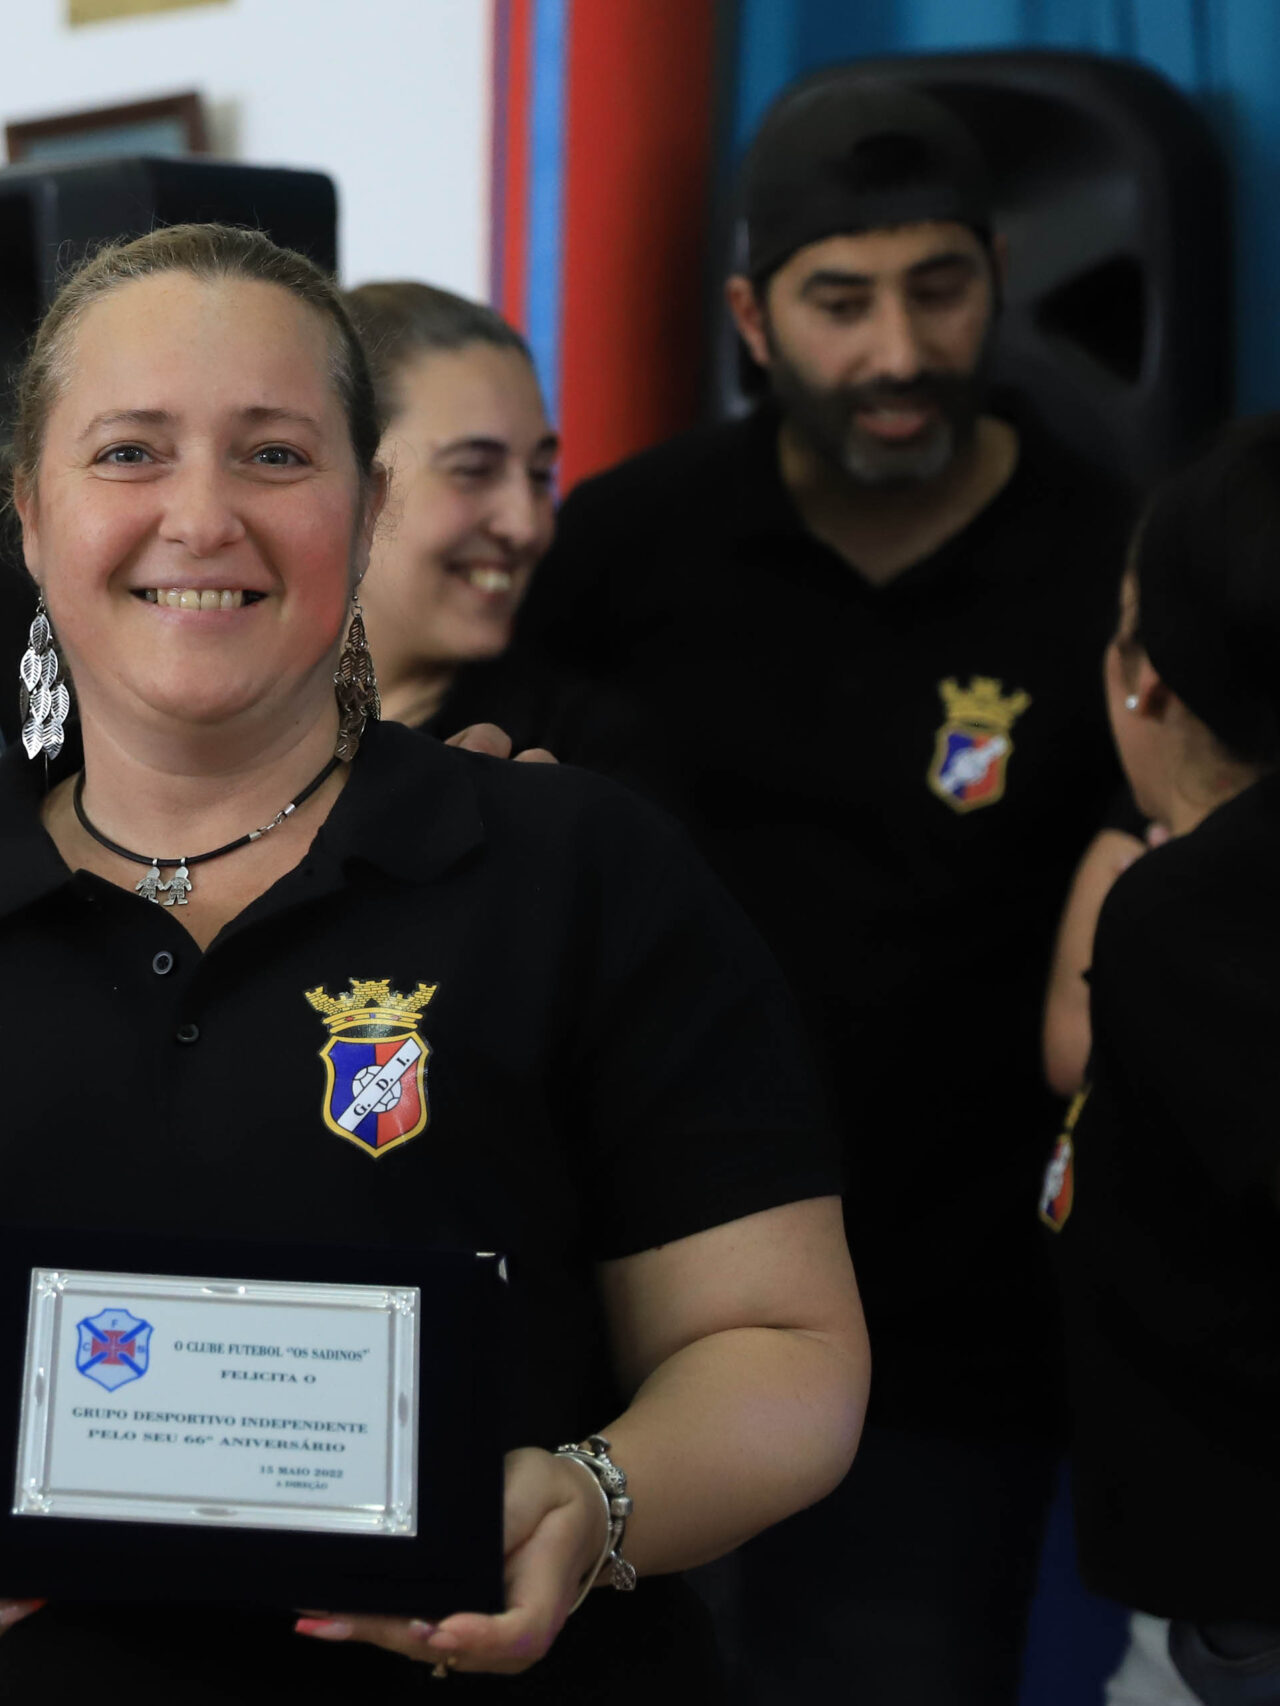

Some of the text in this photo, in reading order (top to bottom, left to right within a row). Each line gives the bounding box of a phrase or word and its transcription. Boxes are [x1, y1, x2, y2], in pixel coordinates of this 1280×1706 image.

[353, 1056, 410, 1118] G. D. I.
[173, 1340, 184, 1351] O
[186, 1341, 224, 1355] CLUBE
[228, 1344, 283, 1358] FUTEBOL
[220, 1369, 317, 1384] FELICITA O
[71, 1406, 368, 1434] GRUPO DESPORTIVO INDEPENDENTE
[87, 1428, 138, 1441] PELO
[142, 1432, 178, 1443] SEU
[219, 1436, 346, 1453] ANIVERSÁRIO
[278, 1466, 310, 1476] MAIO
[313, 1468, 344, 1479] 2022
